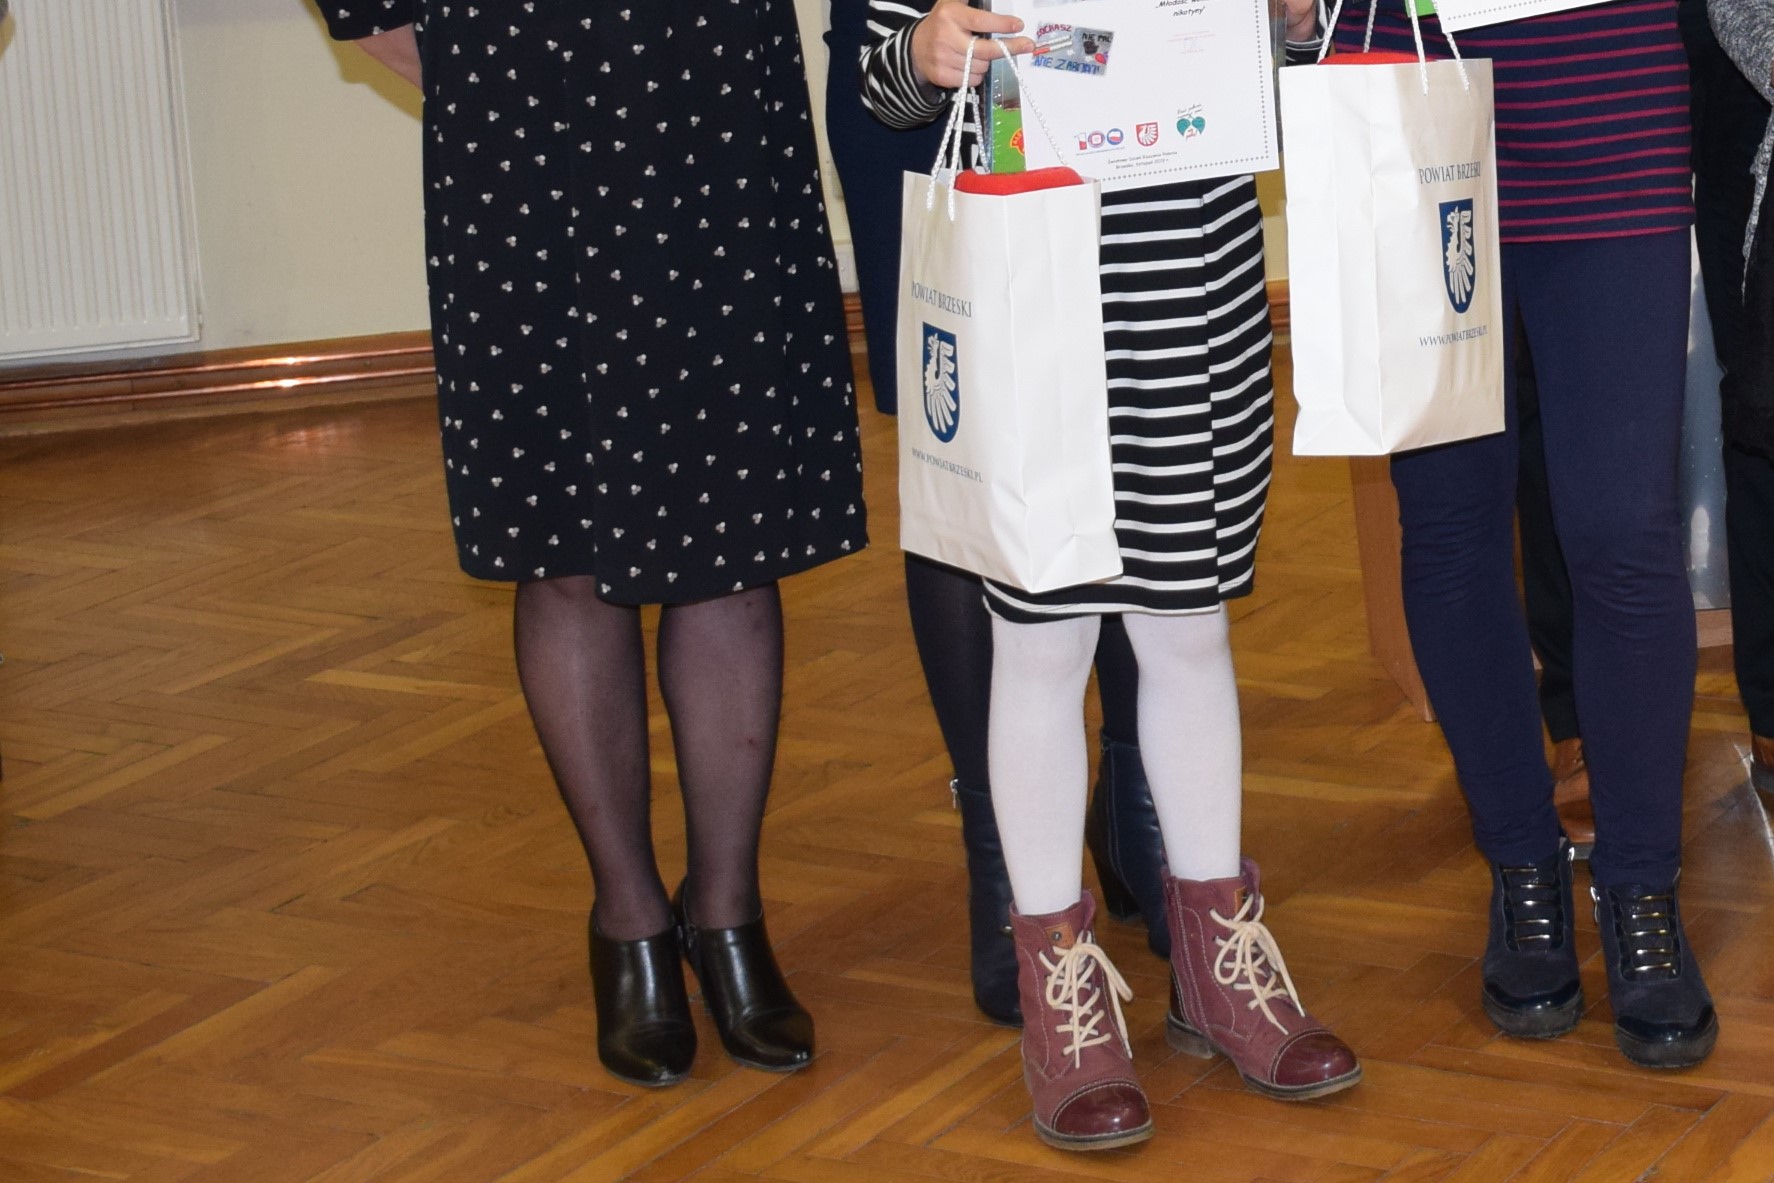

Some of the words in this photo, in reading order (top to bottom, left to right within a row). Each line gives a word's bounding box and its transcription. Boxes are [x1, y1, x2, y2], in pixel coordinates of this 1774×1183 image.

[1418, 164, 1455, 185] POWIAT
[911, 280, 937, 306] POWIAT
[938, 291, 972, 318] BRZESKI
